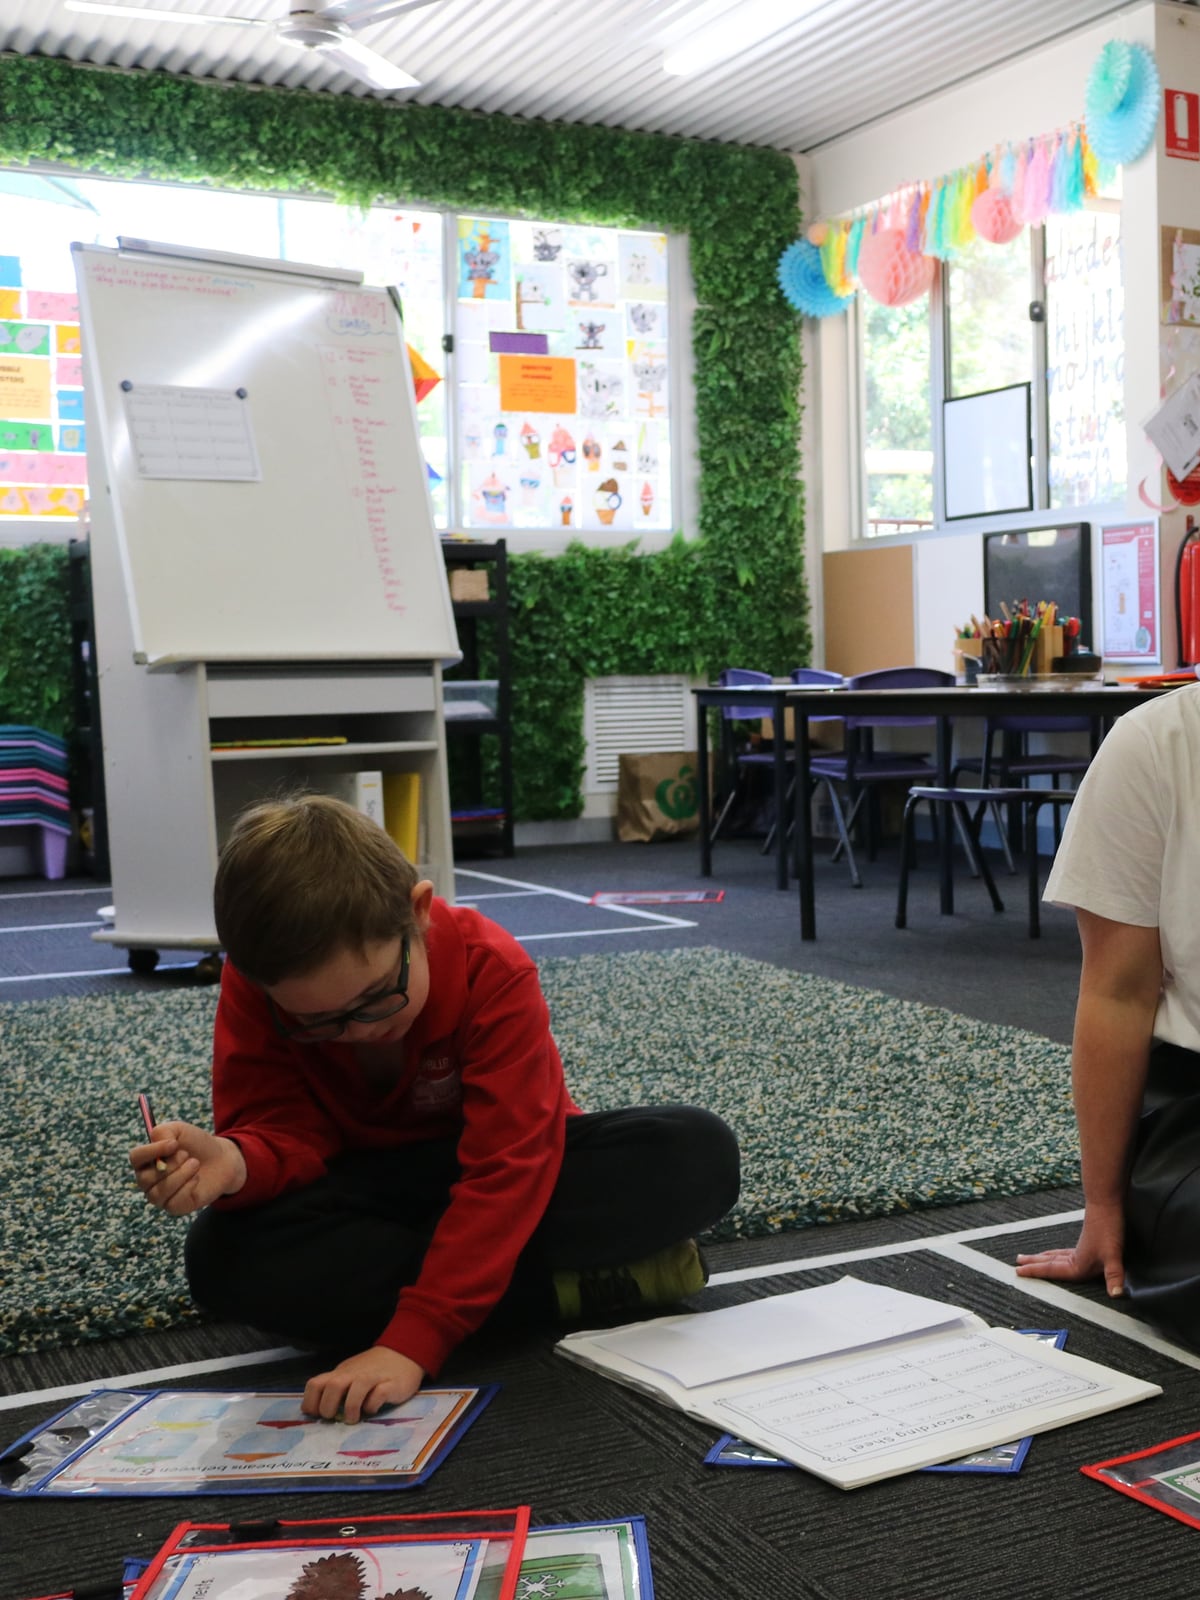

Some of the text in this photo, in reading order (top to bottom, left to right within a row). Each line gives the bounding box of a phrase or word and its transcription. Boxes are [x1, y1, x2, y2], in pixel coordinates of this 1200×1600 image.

[895, 1413, 975, 1438] Recording
[160, 1464, 228, 1474] between
[230, 1461, 309, 1471] jellybeans
[311, 1460, 332, 1470] 12
[336, 1460, 381, 1469] Share
[139, 1468, 156, 1476] 6
